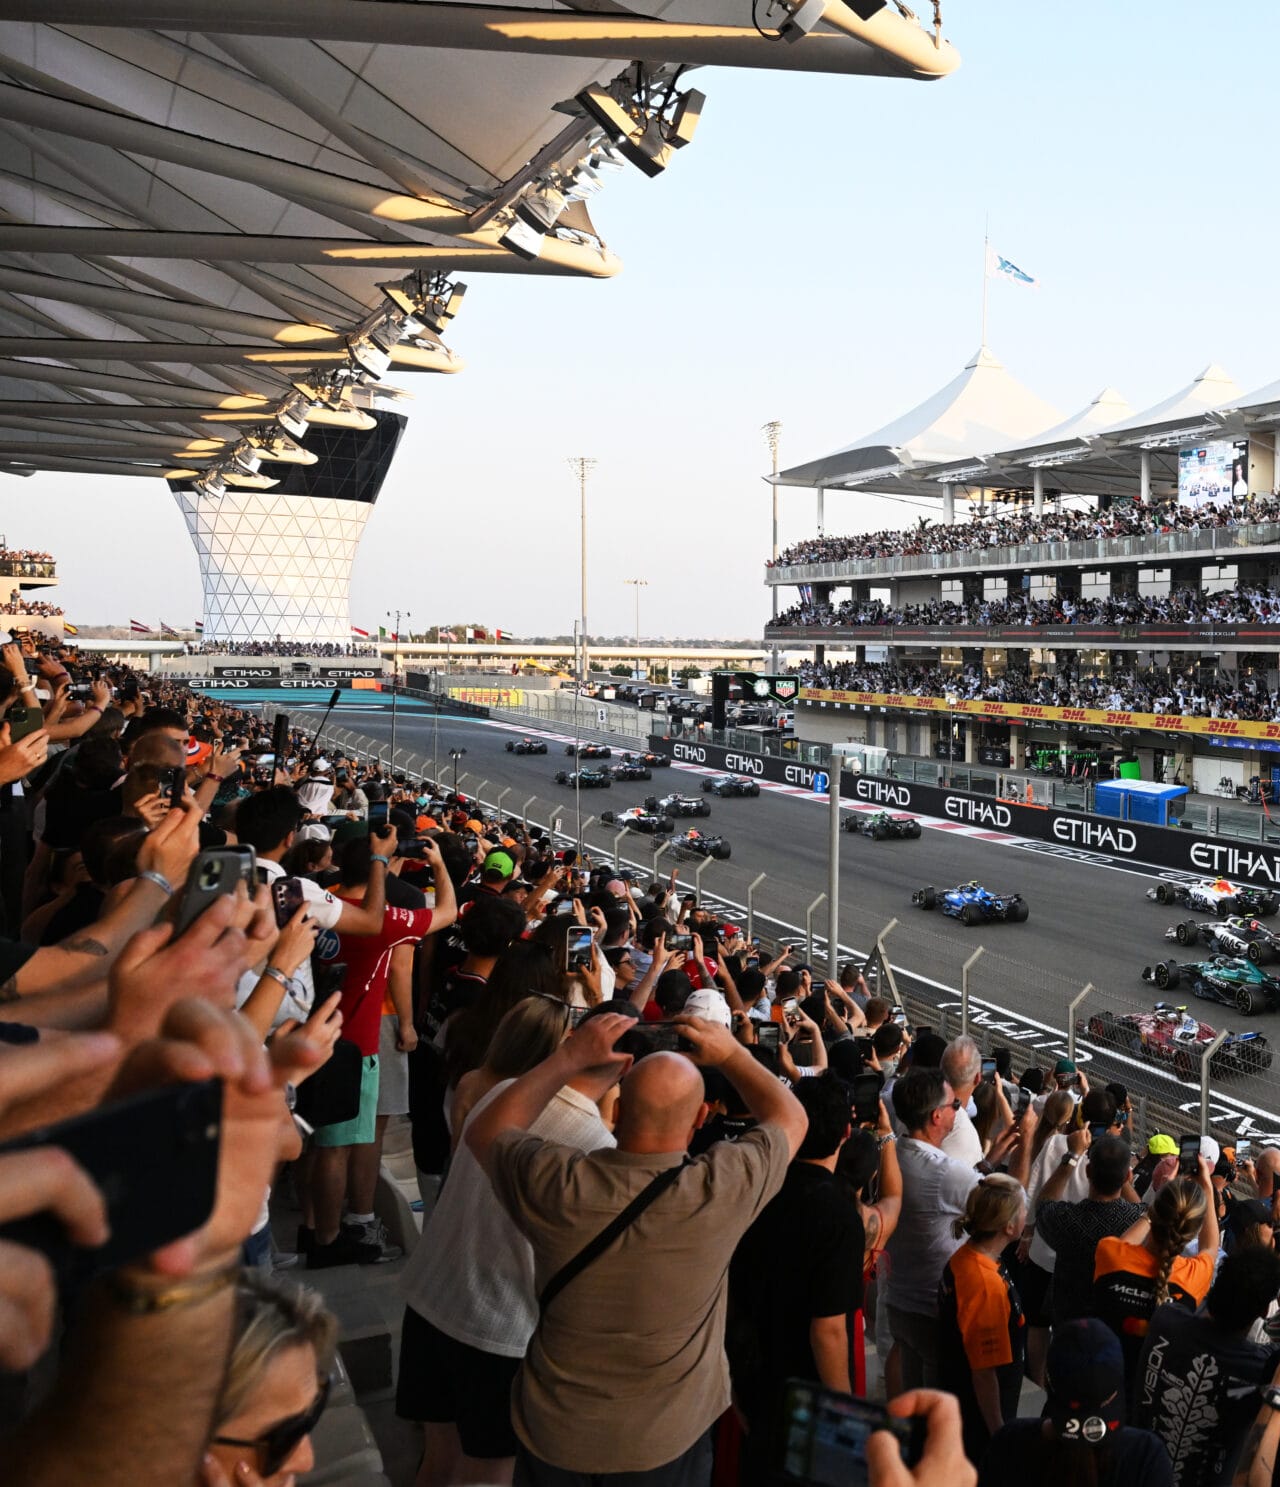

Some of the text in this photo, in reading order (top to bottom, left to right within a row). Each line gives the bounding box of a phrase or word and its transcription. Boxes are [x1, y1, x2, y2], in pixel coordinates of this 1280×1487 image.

[222, 669, 272, 677] ETIHAD
[328, 670, 375, 678] ETIHAD
[188, 678, 249, 688] ETIHAD
[280, 679, 338, 688] ETIHAD
[1061, 709, 1087, 721] DHL
[1105, 712, 1134, 725] DHL
[1154, 716, 1184, 730] DHL
[1207, 720, 1239, 734] DHL
[673, 743, 706, 763] ETIHAD
[725, 753, 764, 775] ETIHAD
[856, 779, 911, 806] ETIHAD
[945, 796, 1011, 828] ETIHAD
[1053, 817, 1137, 852] ETIHAD
[1207, 976, 1228, 988] aramco
[1142, 1335, 1170, 1404] VISION
